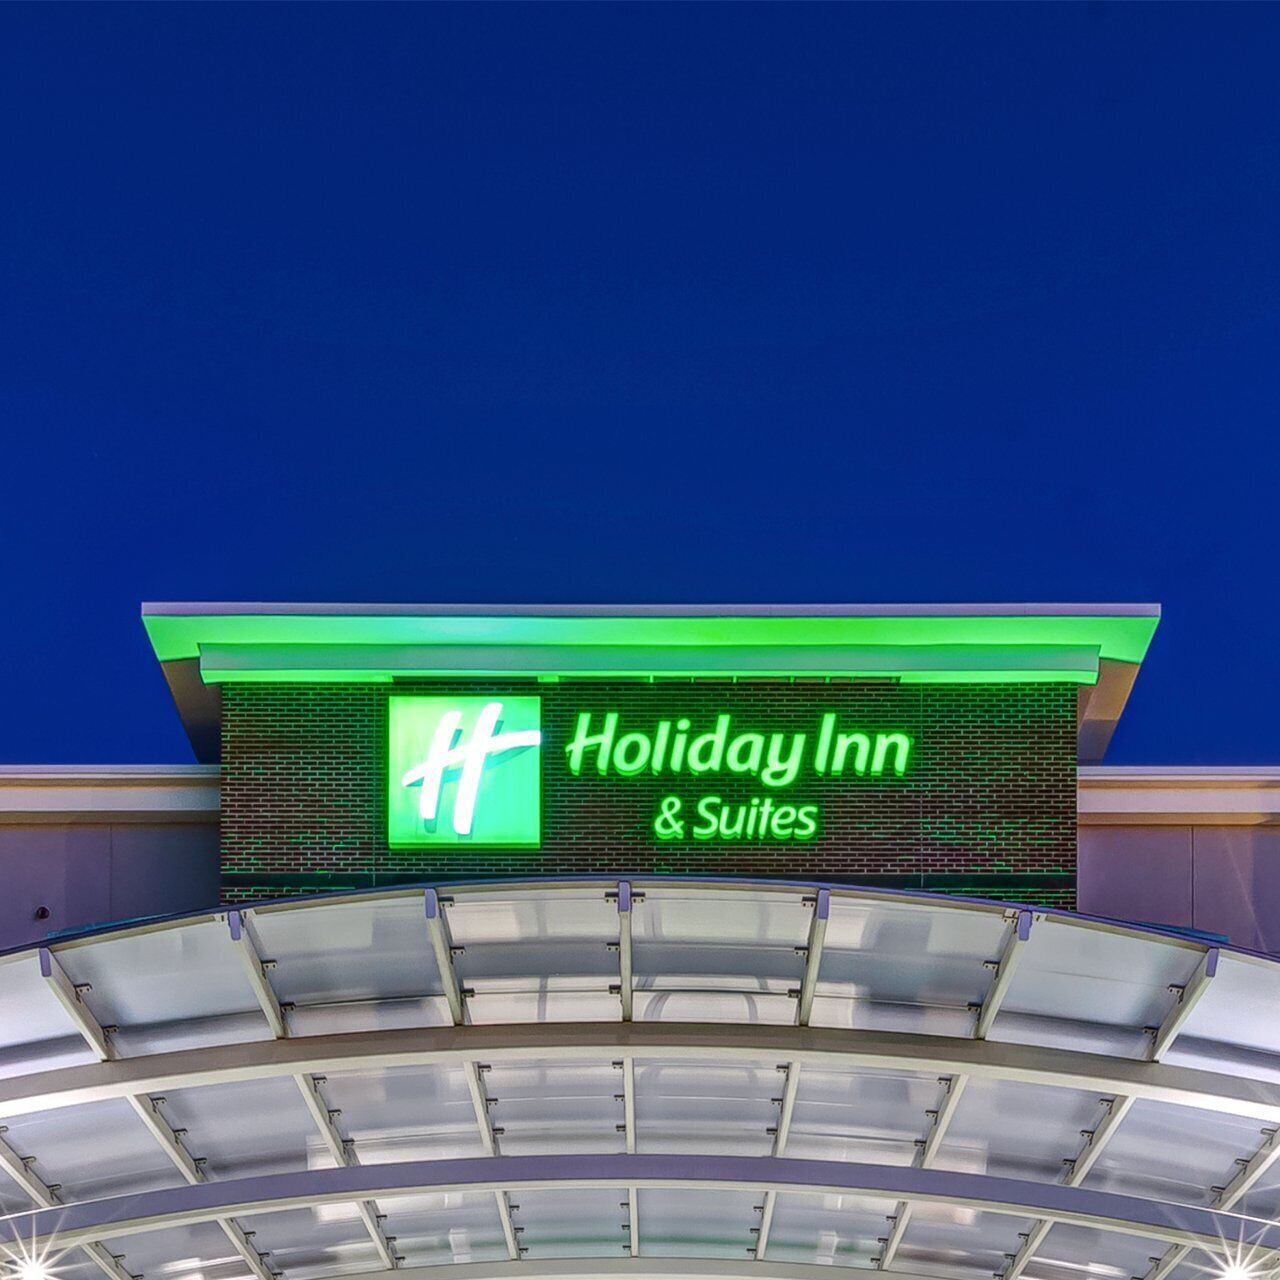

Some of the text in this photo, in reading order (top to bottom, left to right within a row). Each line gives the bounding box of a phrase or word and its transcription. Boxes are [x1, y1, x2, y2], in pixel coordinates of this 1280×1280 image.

[565, 712, 912, 787] Holiday Inn
[654, 796, 818, 840] & Suites
